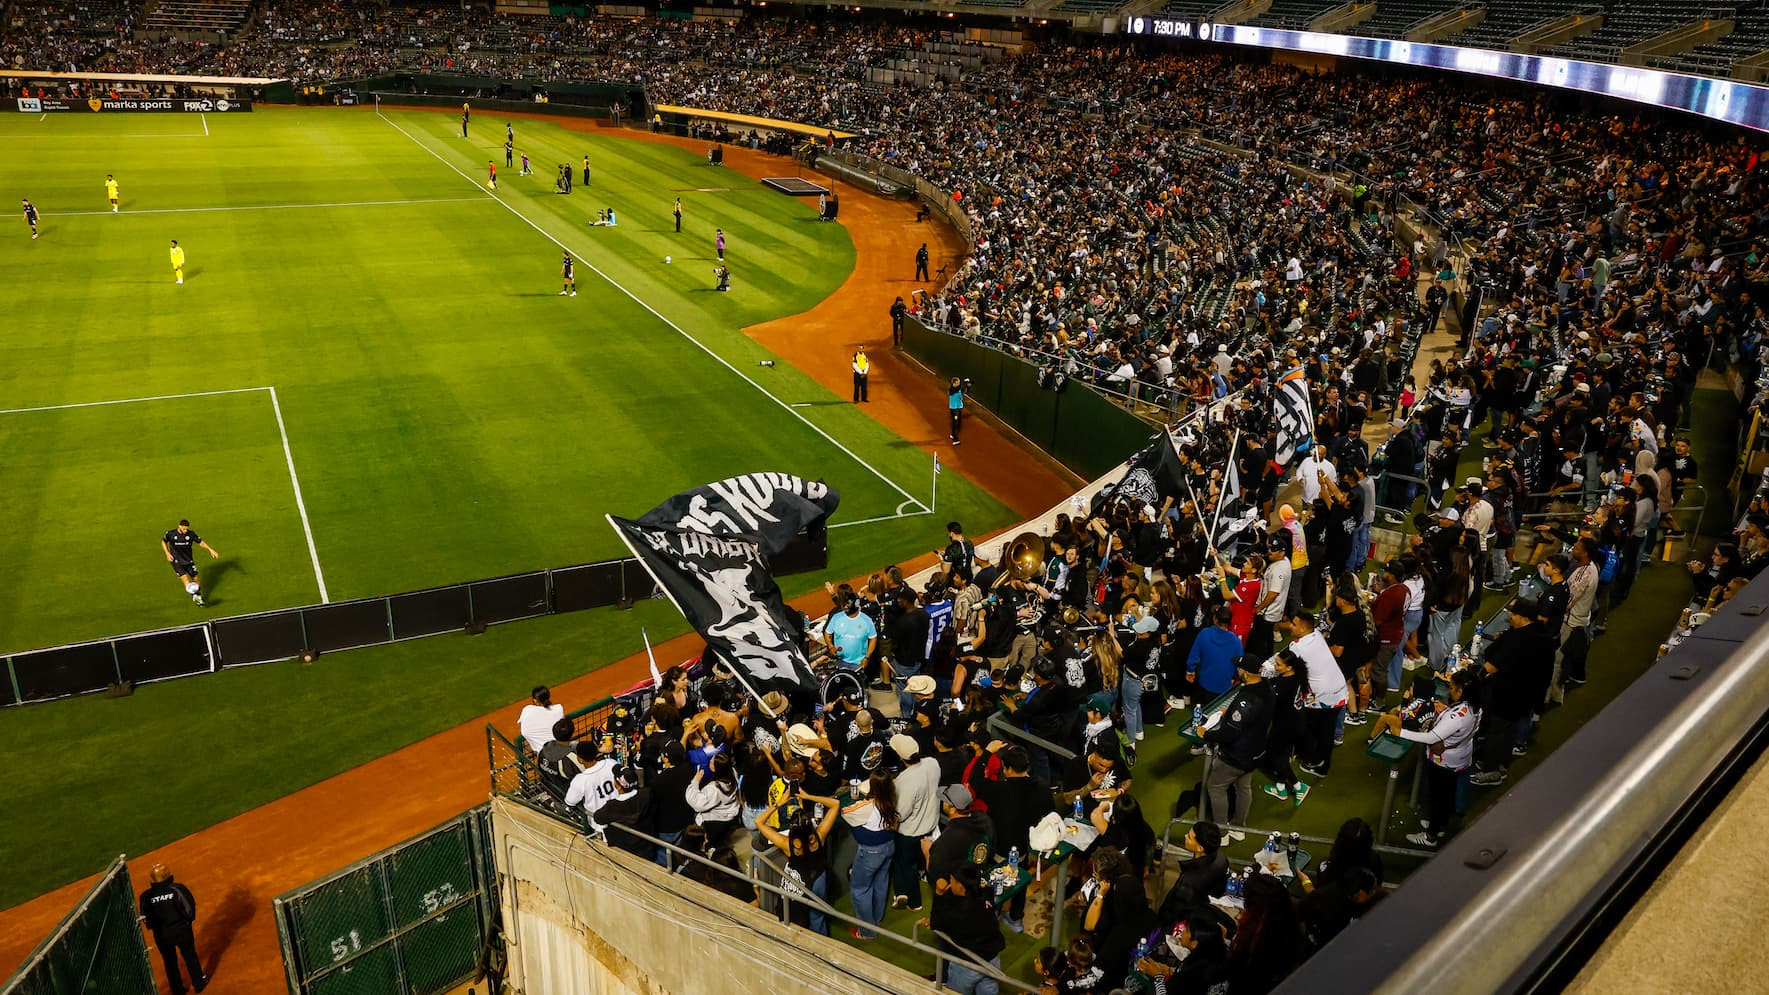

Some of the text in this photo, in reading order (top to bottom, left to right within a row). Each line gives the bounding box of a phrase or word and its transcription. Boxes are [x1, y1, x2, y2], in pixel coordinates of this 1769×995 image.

[1154, 20, 1190, 36] 7:30 PM
[104, 101, 172, 111] marka sports
[938, 614, 946, 633] 5
[596, 780, 614, 799] 10
[151, 893, 174, 903] STAFF
